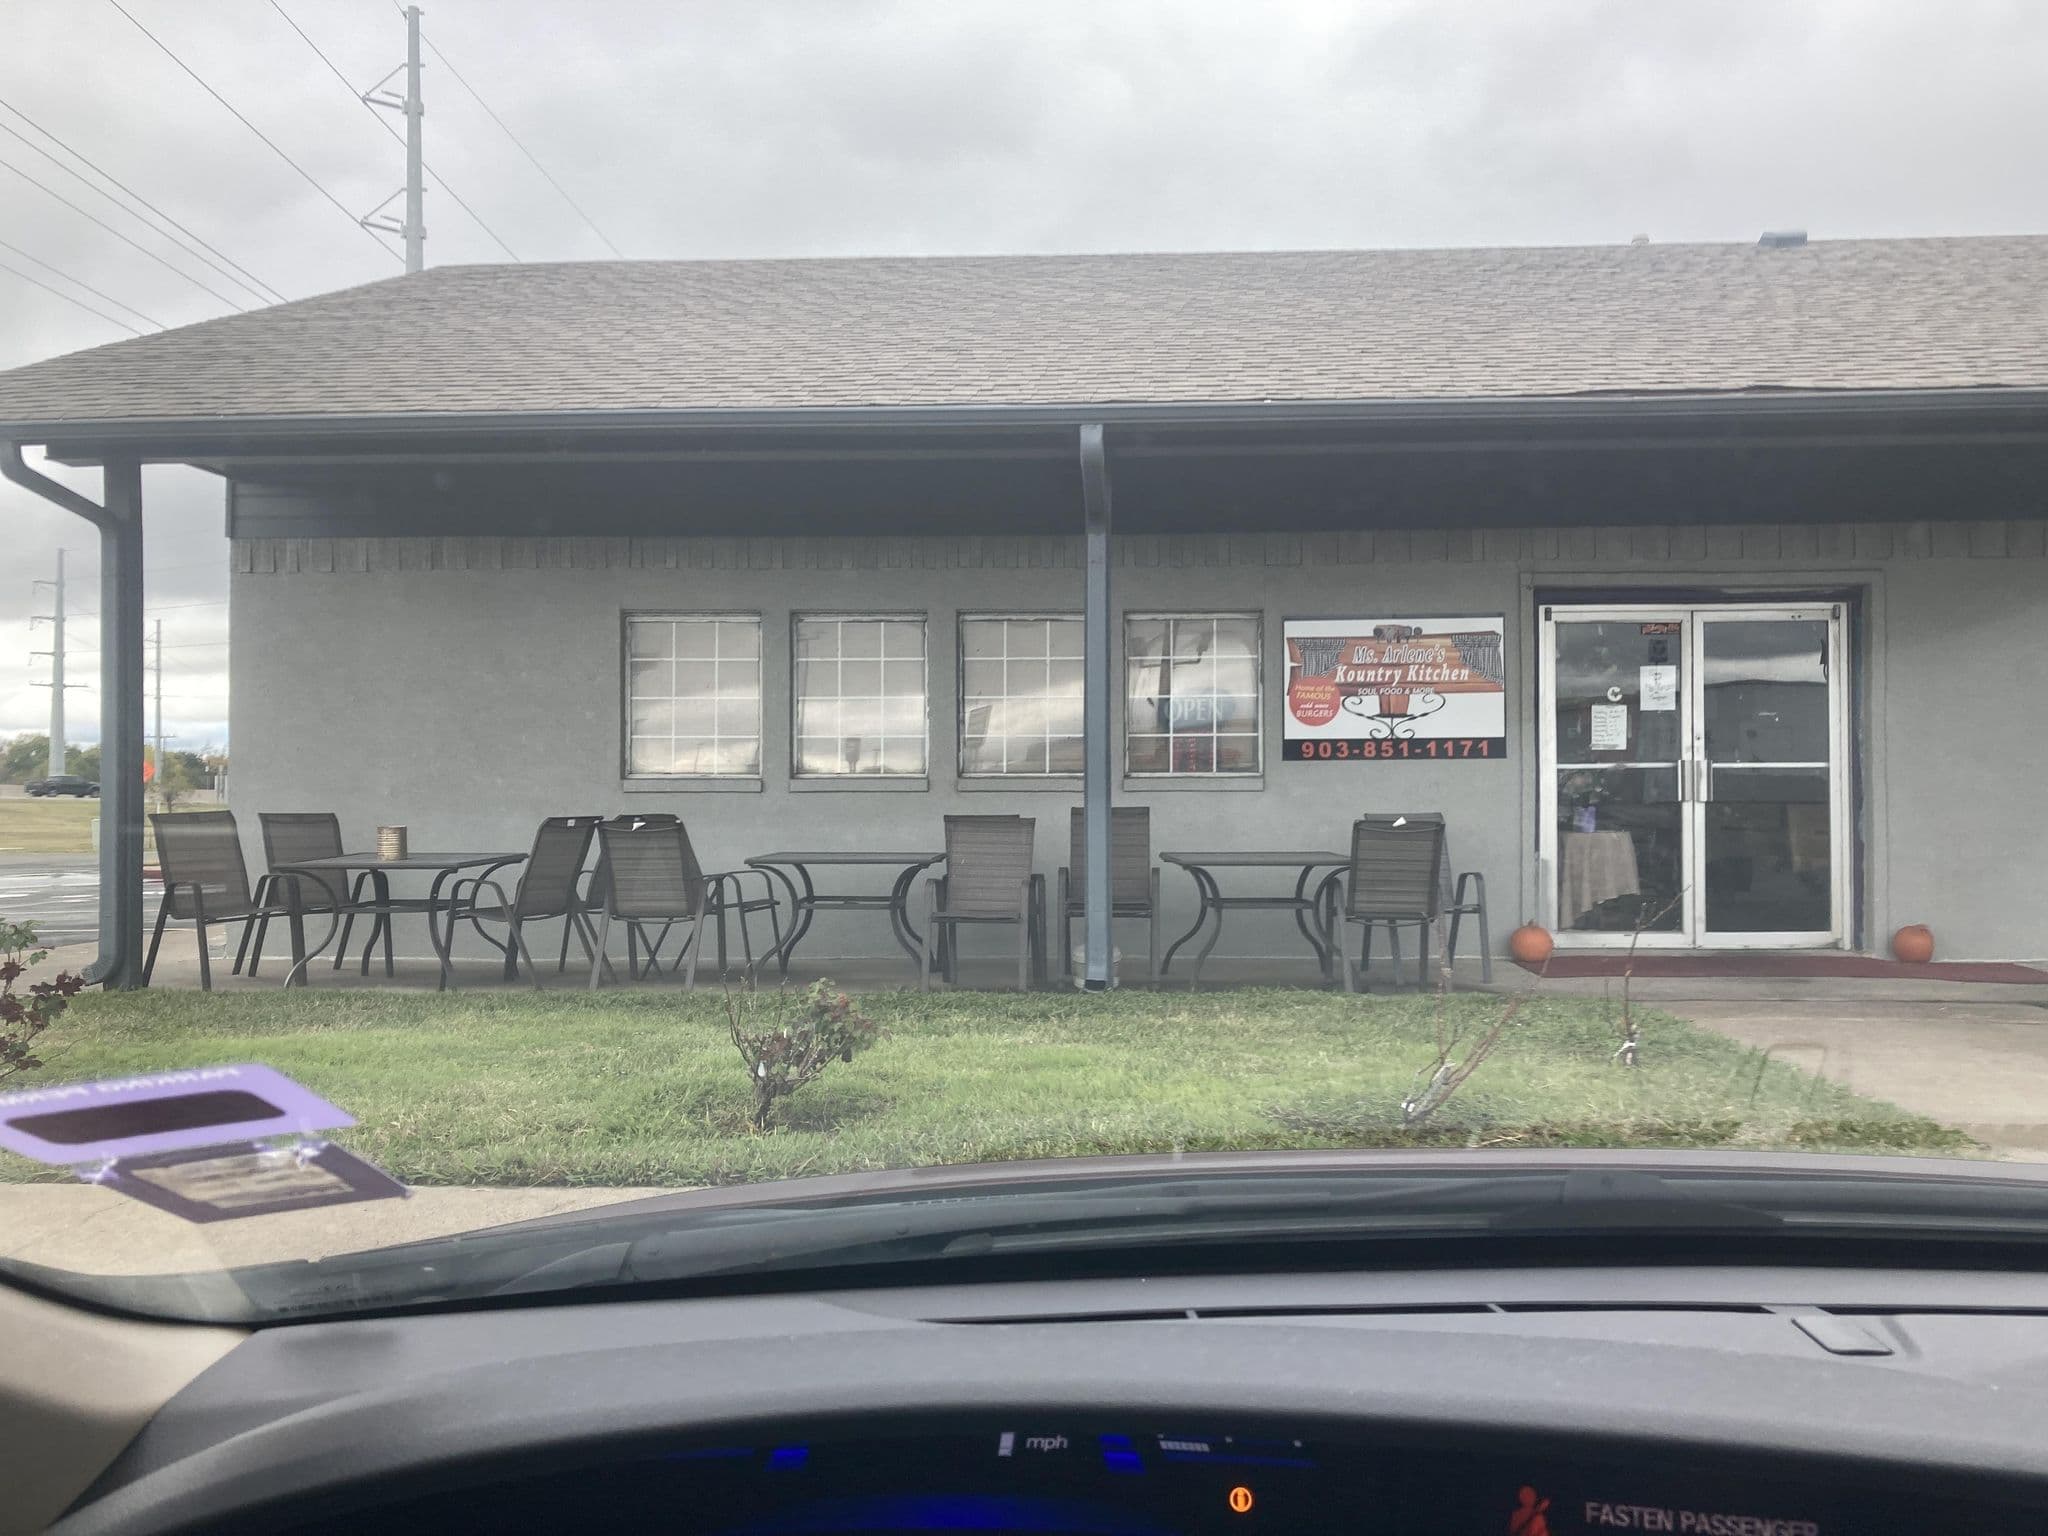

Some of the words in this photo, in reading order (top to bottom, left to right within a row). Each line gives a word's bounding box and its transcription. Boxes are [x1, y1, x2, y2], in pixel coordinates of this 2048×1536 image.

[1352, 645, 1378, 664] Ms.
[1382, 643, 1446, 664] Arlene's
[1335, 664, 1402, 687] Kountry
[1407, 662, 1469, 681] Kitchen
[1296, 691, 1332, 701] FAMOUS
[1380, 687, 1402, 695] FOOD
[1404, 687, 1411, 695] &
[1412, 687, 1434, 695] MORE
[1164, 697, 1223, 721] OPEN
[1296, 709, 1334, 718] BURGERS
[1301, 740, 1489, 758] 903-851-1171
[1025, 1434, 1068, 1452] mph
[1585, 1501, 1674, 1532] FASTEN
[1680, 1510, 1819, 1536] PASSENGER
